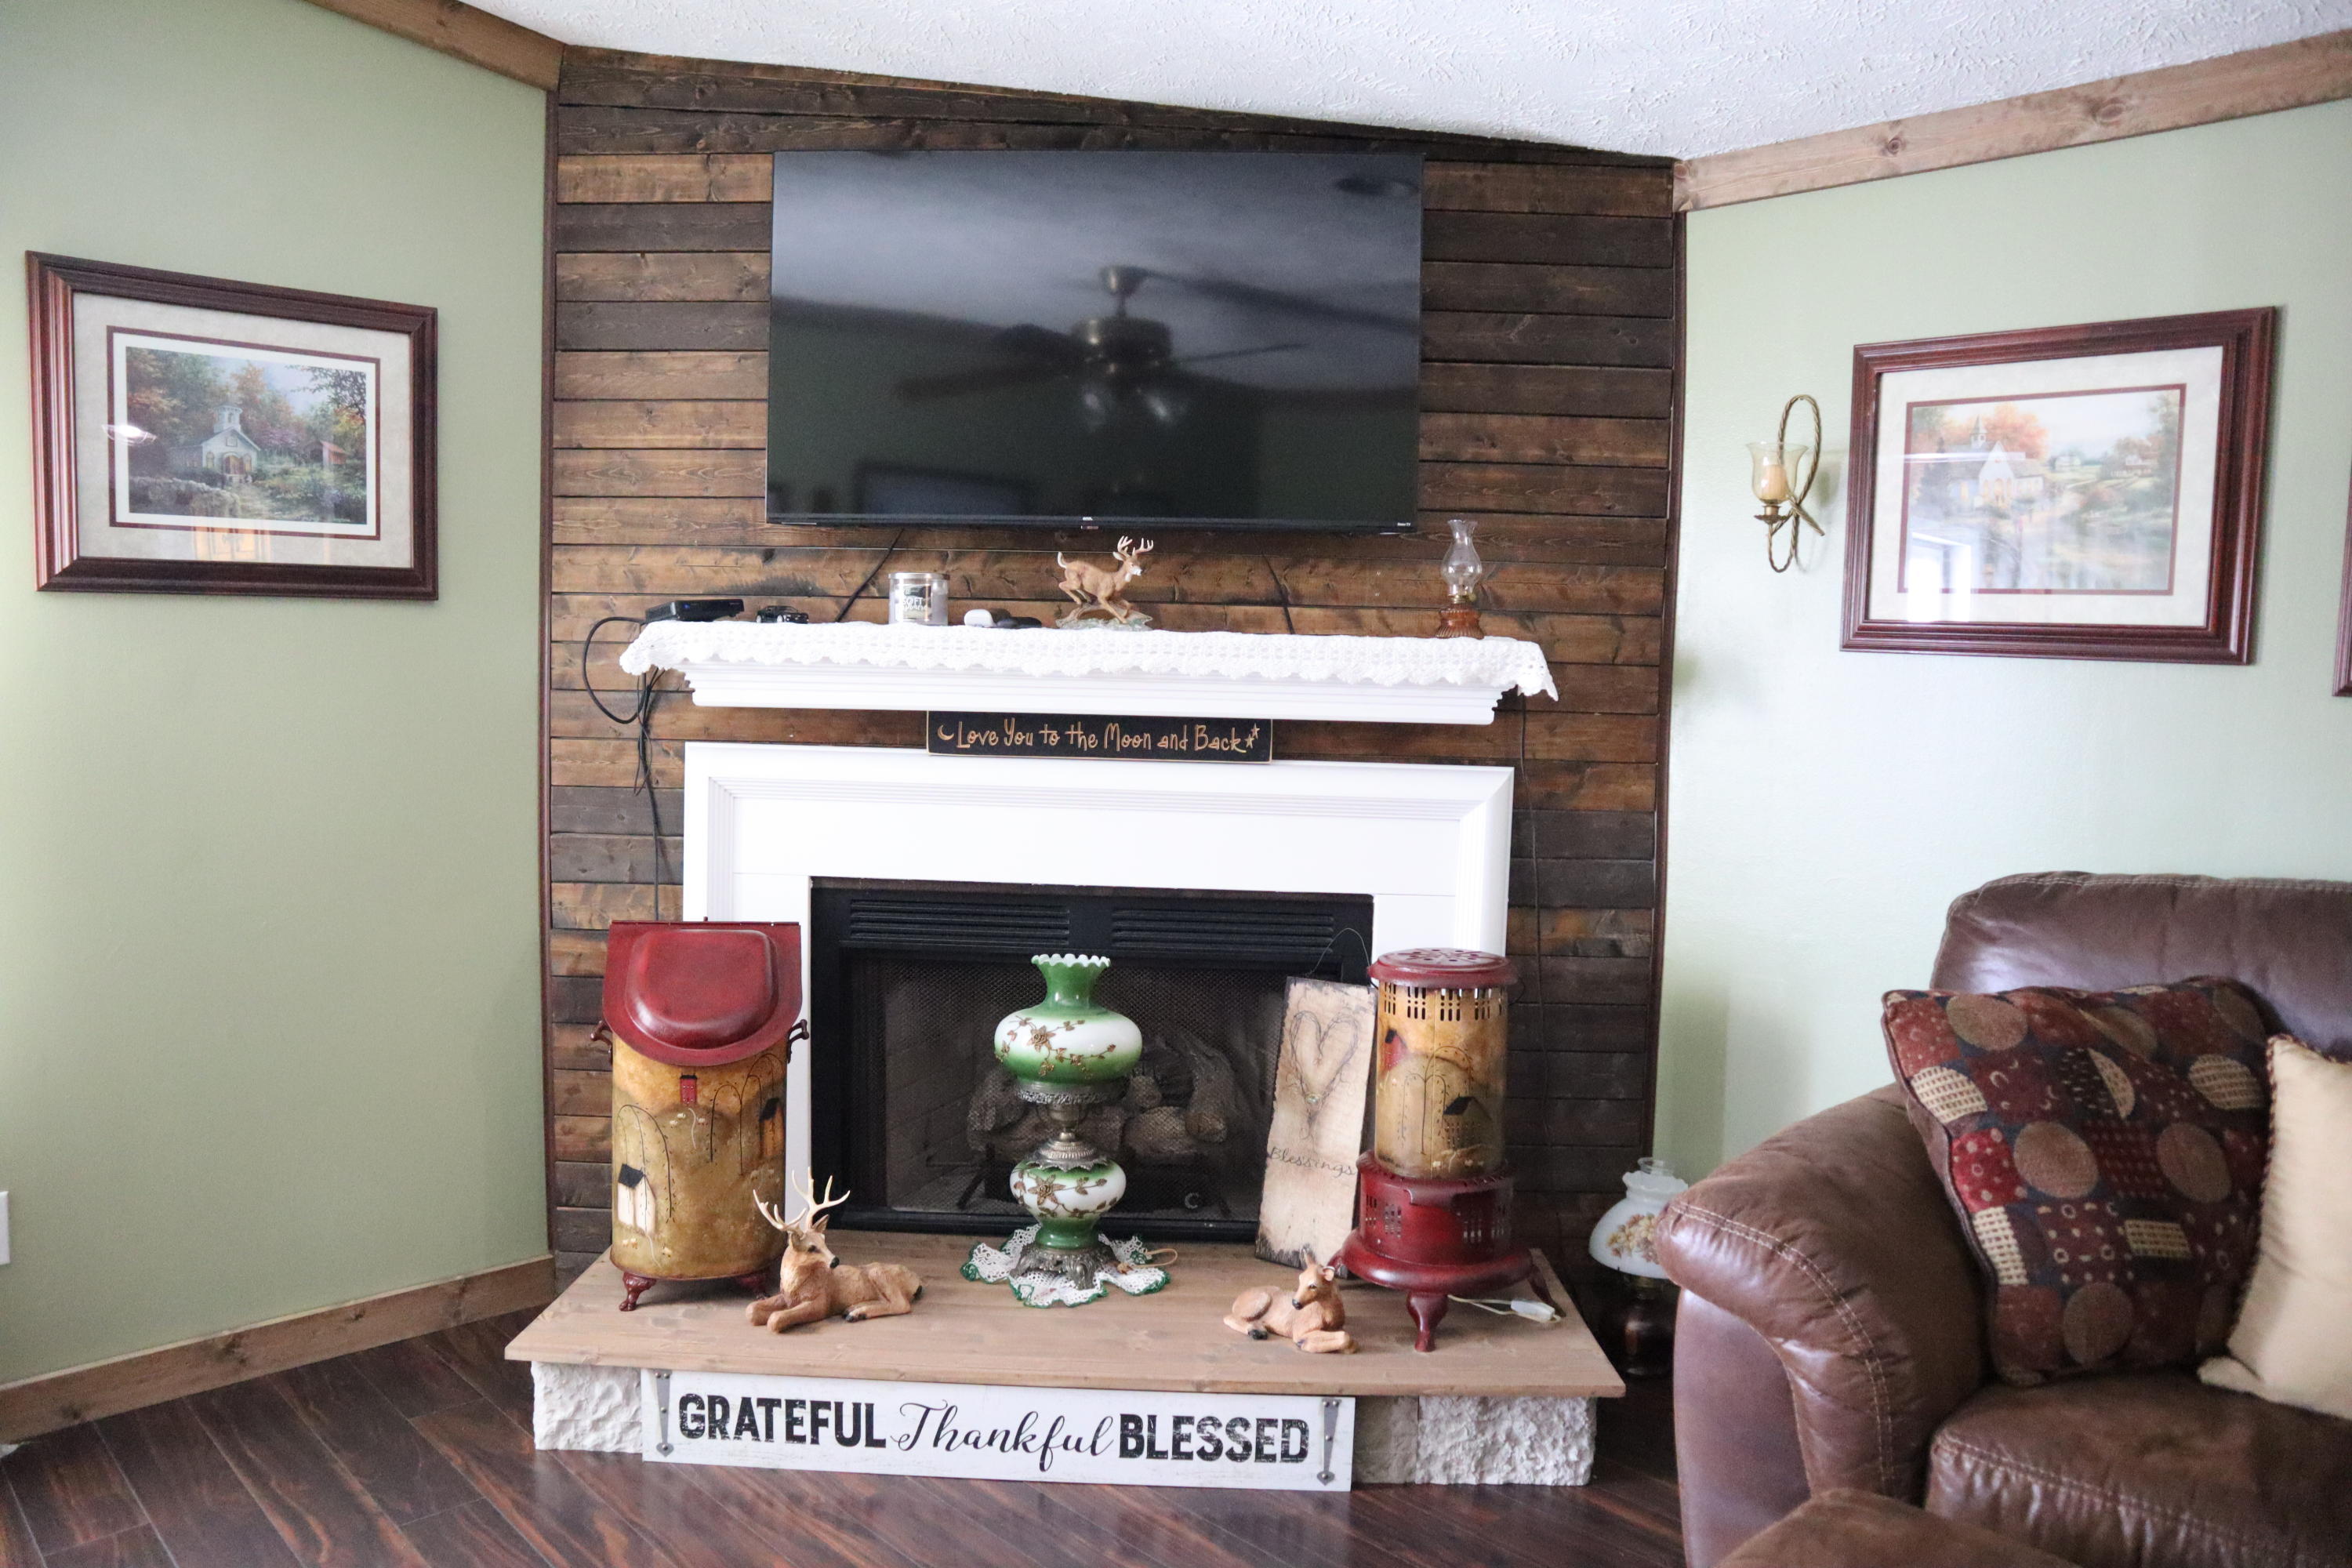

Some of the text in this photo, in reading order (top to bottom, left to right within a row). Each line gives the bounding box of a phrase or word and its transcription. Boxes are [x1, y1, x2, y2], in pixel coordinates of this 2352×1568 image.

[956, 717, 1247, 753] Love You to the Moon and Back
[1270, 1146, 1356, 1178] Blessings
[679, 1393, 1309, 1472] GRATEFUL Thankful BLESSED
